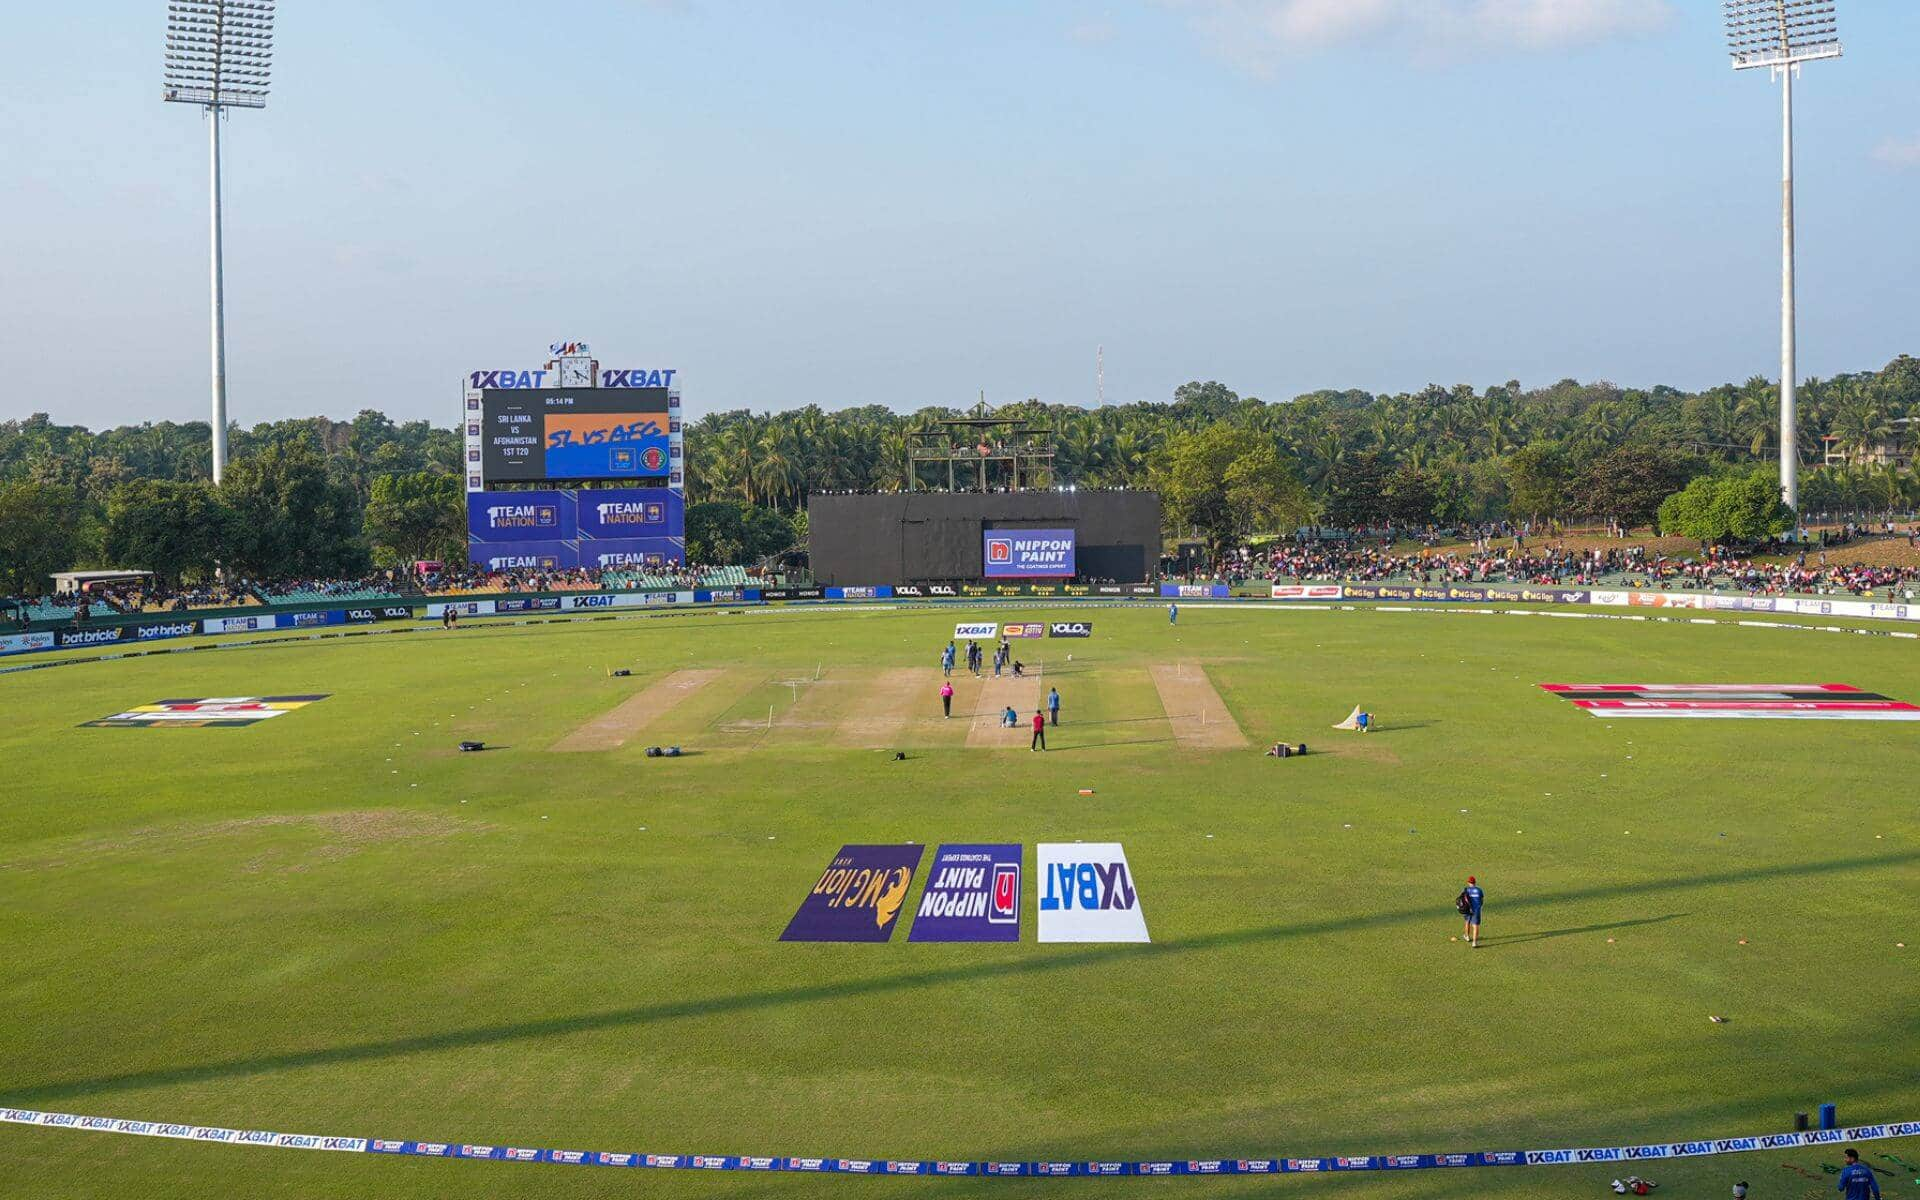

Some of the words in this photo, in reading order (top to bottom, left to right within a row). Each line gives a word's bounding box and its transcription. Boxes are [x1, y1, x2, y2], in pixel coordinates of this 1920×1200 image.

[470, 370, 546, 388] 1XBAT
[602, 370, 676, 387] 1XBAT
[497, 518, 534, 527] NATION
[607, 514, 643, 524] NATION
[1015, 540, 1072, 550] NIPPON
[1021, 552, 1065, 562] PAINT
[896, 586, 917, 594] YOLO
[929, 586, 950, 594] YOLO
[573, 596, 616, 607] 1XBAT
[349, 610, 372, 619] YOLO
[384, 608, 406, 616] YOLO
[1051, 624, 1083, 632] YOLO
[934, 868, 985, 888] PAINT
[1040, 863, 1136, 910] 1XBAT
[918, 892, 988, 917] NIPPON
[5, 1110, 39, 1122] 1XBAT
[43, 1115, 79, 1126] 1XBAT
[81, 1118, 117, 1129] 1XBAT
[118, 1121, 154, 1133] 1XBAT
[1890, 1122, 1920, 1136] 1XBA
[157, 1124, 194, 1136] 1XBAT
[197, 1128, 235, 1140] 1XBAT
[1805, 1129, 1844, 1143] 1XBAT
[1847, 1126, 1885, 1139] 1XBAT
[238, 1131, 277, 1143] 1XBAT
[279, 1136, 320, 1147] 1XBAT
[1761, 1133, 1801, 1147] 1XBAT
[323, 1138, 364, 1149] 1XBAT
[1671, 1142, 1712, 1156] 1XBAT
[1717, 1138, 1757, 1151] 1XBAT
[1528, 1151, 1573, 1164] 1XBAT
[1578, 1148, 1620, 1161] 1XBAT
[1625, 1145, 1668, 1158] 1XBAT
